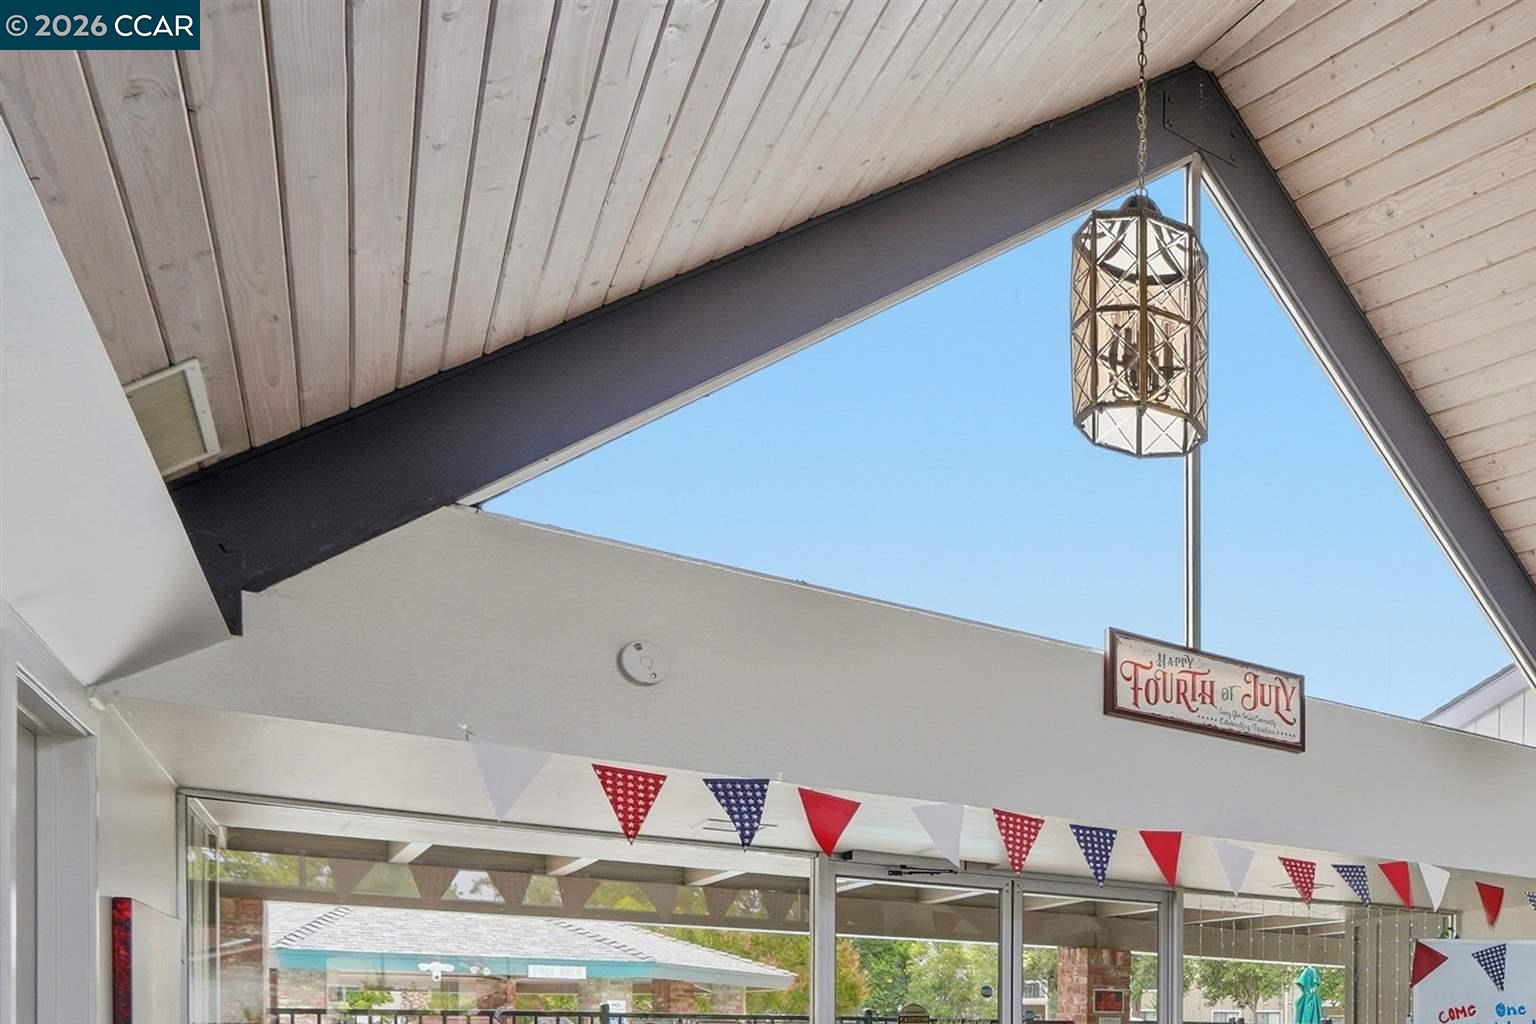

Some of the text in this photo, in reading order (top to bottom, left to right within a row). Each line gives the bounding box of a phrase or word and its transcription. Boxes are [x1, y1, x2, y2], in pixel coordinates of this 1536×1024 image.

[1156, 652, 1195, 669] HAPPY
[1119, 659, 1219, 714] FOURTH
[1241, 671, 1297, 726] JULY
